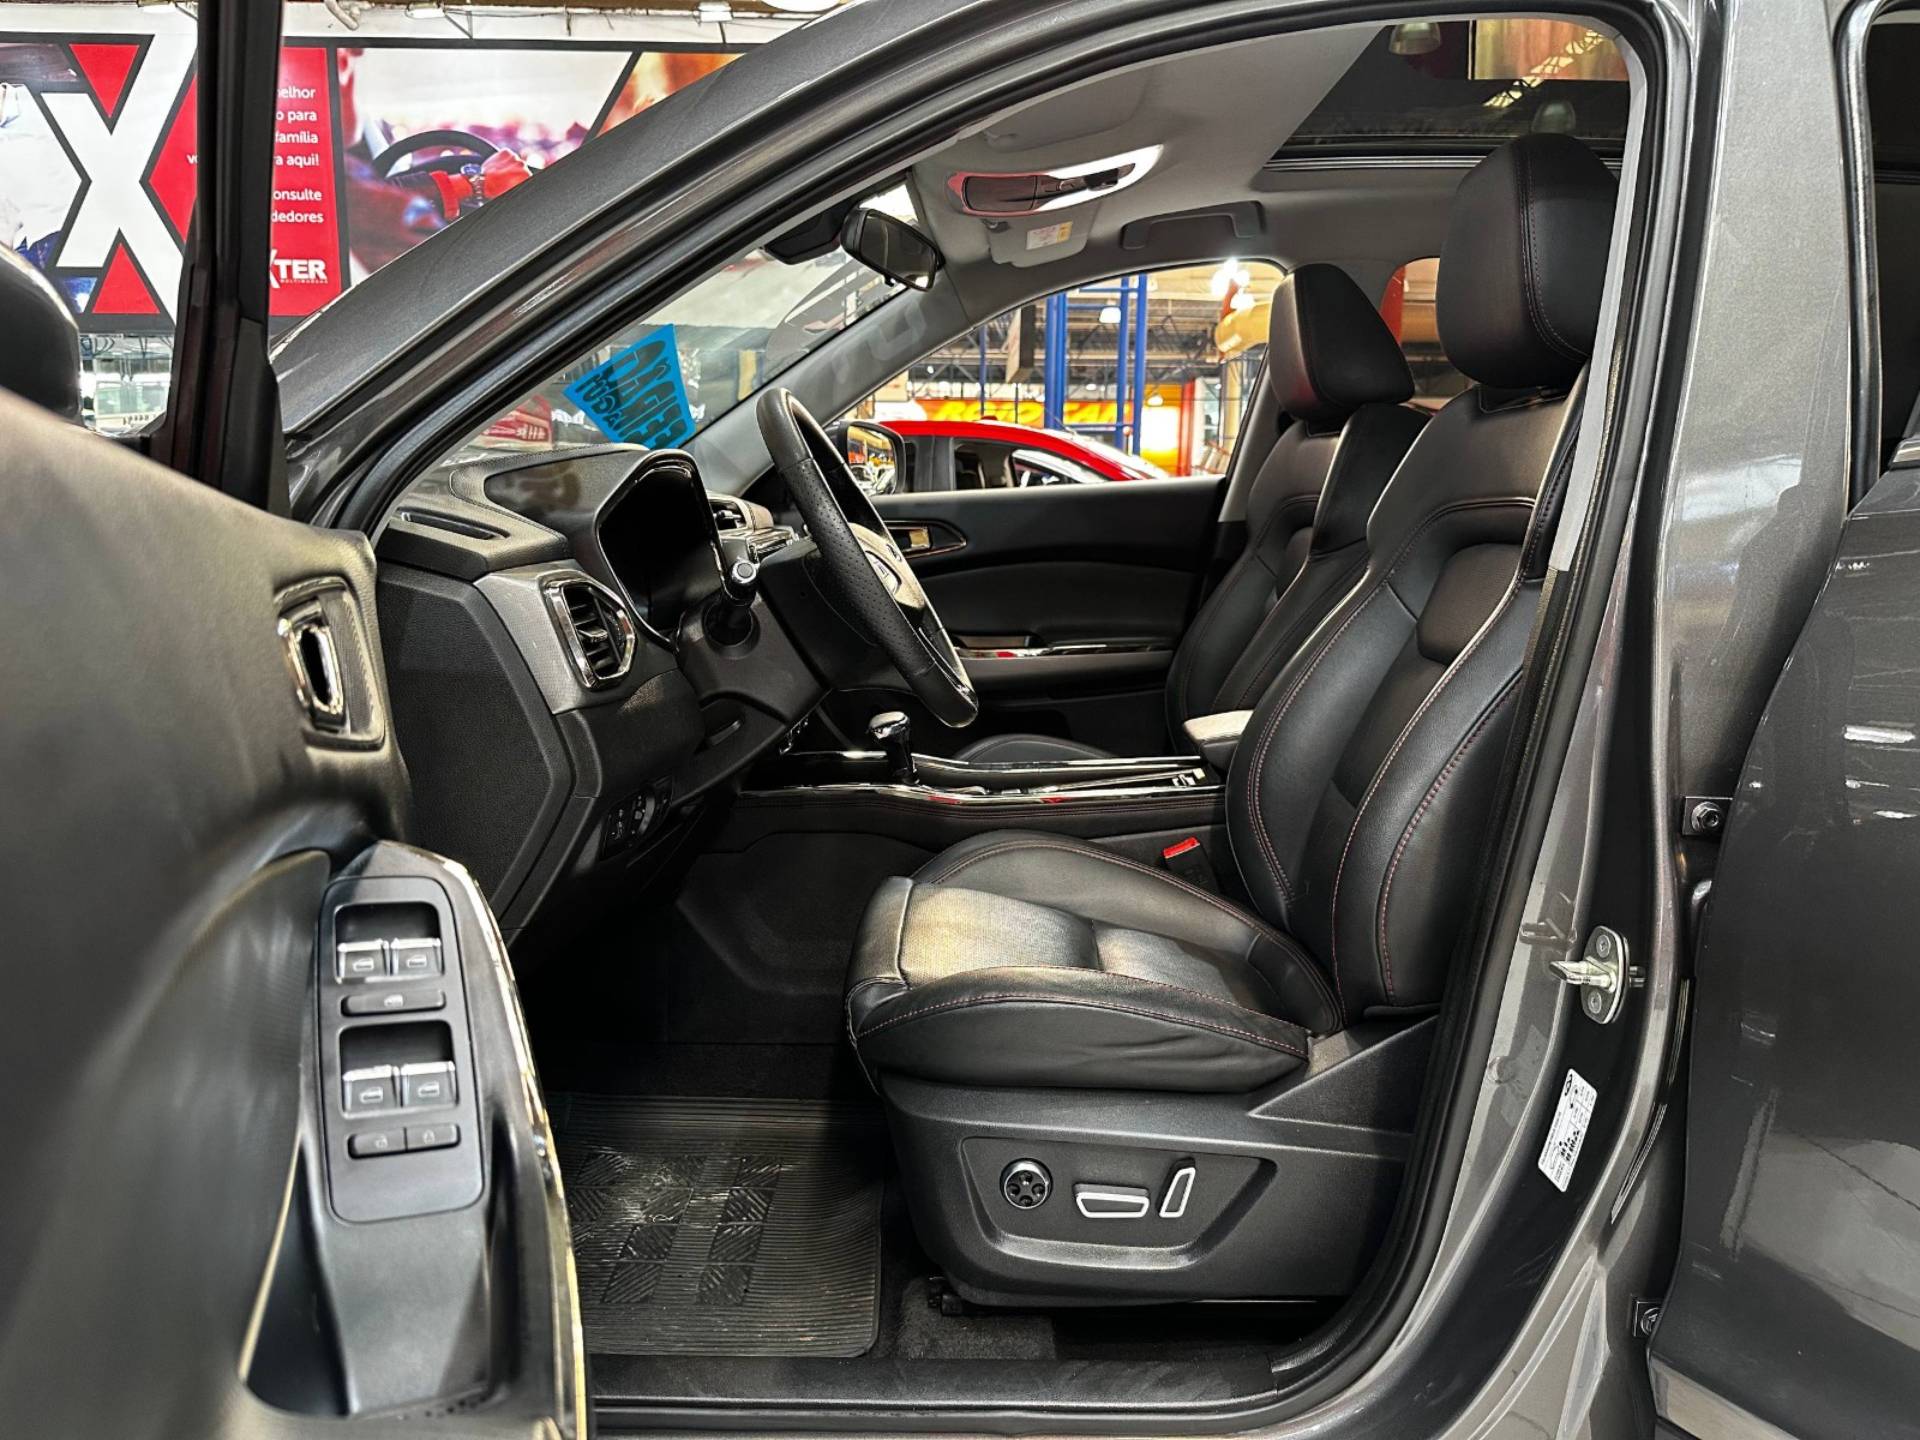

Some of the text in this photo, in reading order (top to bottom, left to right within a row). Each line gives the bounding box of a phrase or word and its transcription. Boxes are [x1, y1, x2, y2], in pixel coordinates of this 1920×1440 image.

[287, 110, 318, 123] para
[286, 153, 320, 168] aqui!
[272, 188, 322, 201] onsulte
[271, 210, 324, 223] dedores
